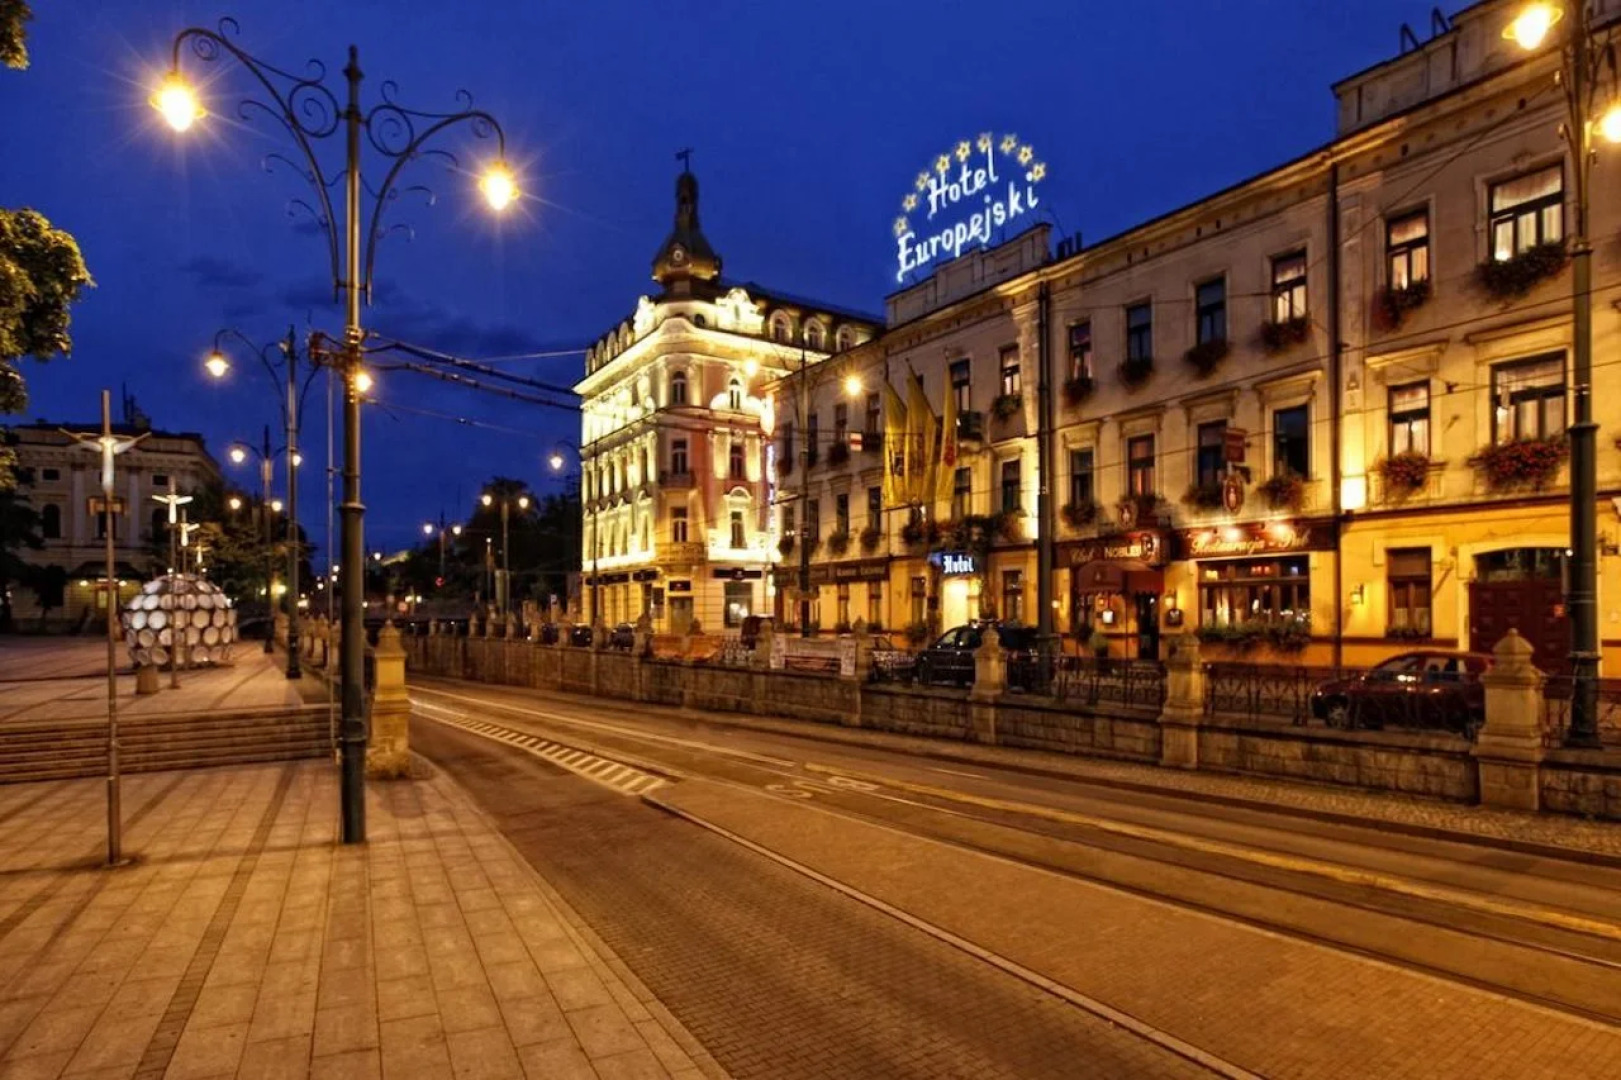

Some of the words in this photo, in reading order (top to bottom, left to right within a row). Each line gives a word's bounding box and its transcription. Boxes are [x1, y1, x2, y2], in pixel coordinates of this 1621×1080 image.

[926, 133, 999, 220] Hotel
[897, 171, 1039, 282] Europejski
[943, 554, 975, 574] Hotel
